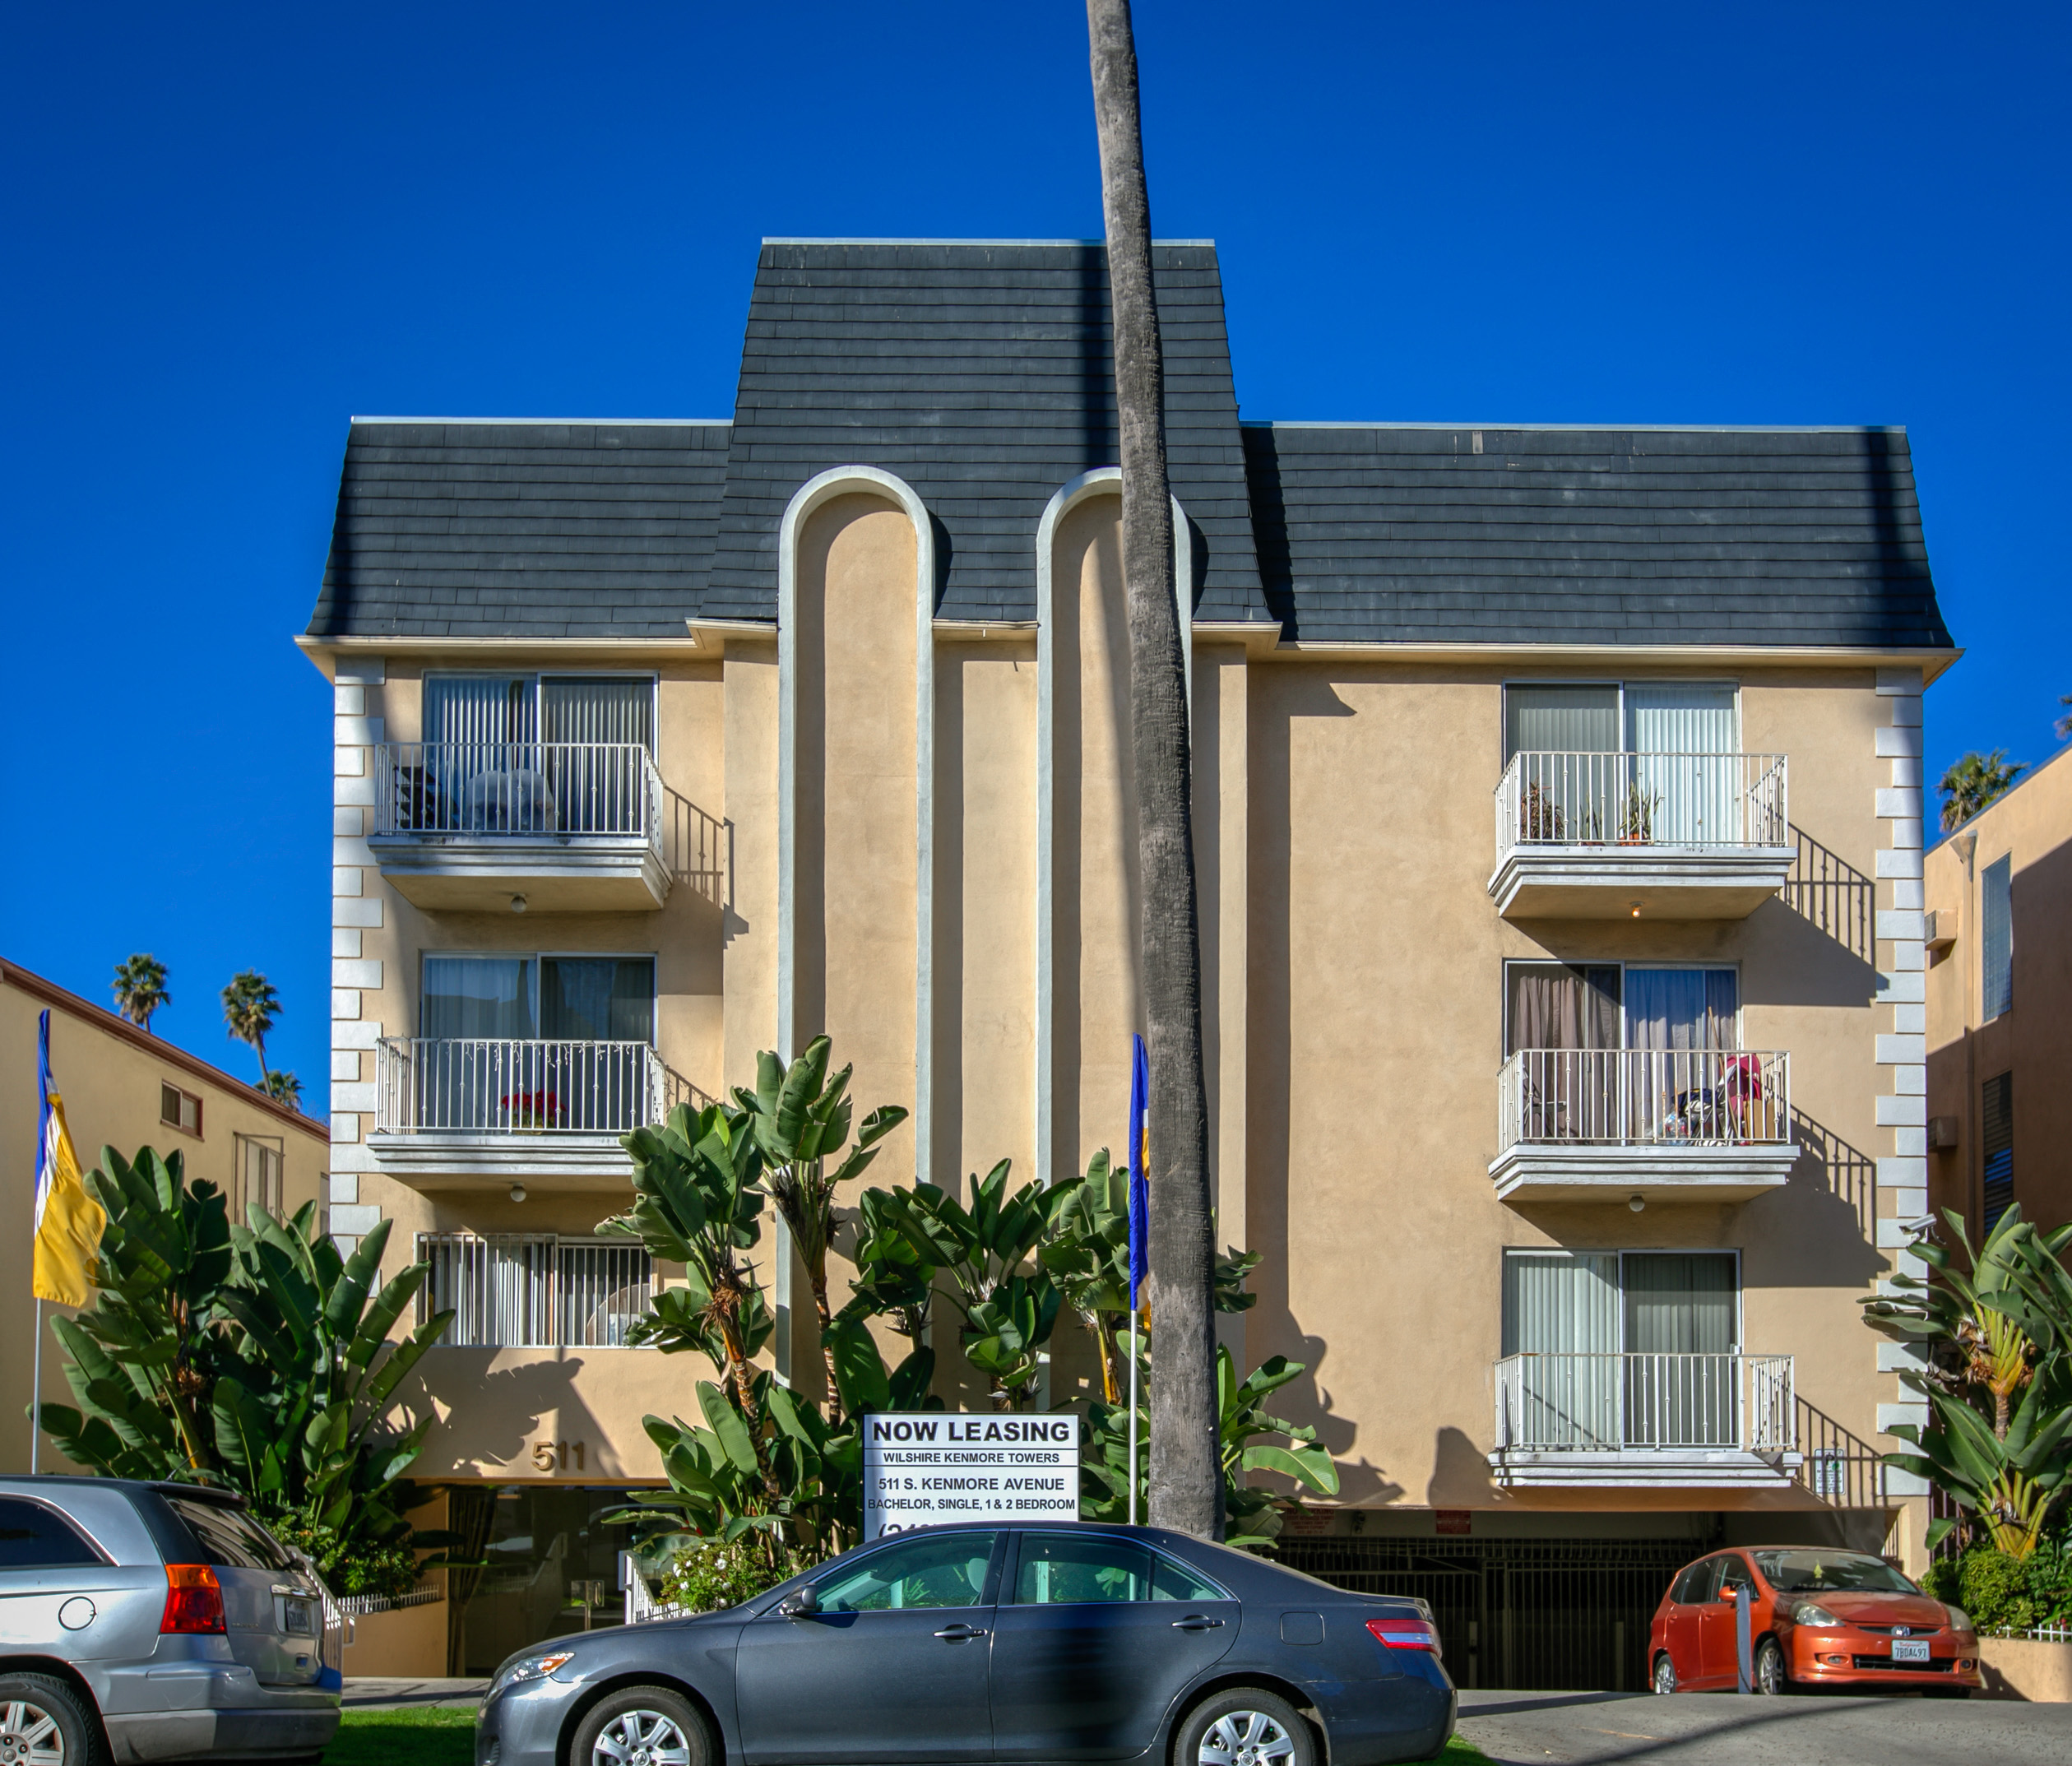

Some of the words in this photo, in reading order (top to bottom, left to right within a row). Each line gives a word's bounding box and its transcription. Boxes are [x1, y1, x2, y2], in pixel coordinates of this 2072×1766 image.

[873, 1421, 939, 1441] NOW
[948, 1421, 1069, 1442] LEASING
[531, 1439, 585, 1471] 511
[883, 1453, 941, 1462] WILSHIRE
[944, 1453, 1004, 1462] KENMORE
[1008, 1453, 1059, 1462] TOWERS
[878, 1478, 899, 1490] 511
[903, 1478, 917, 1490] S.
[922, 1478, 999, 1490] KENMORE
[1004, 1478, 1064, 1490] AVENUE
[868, 1499, 934, 1511] BACHELOR,
[938, 1499, 983, 1511] SINGLE,
[985, 1499, 990, 1509] 1
[994, 1499, 1002, 1509] &
[1006, 1499, 1013, 1509] 2
[1016, 1499, 1075, 1509] BEDROOM
